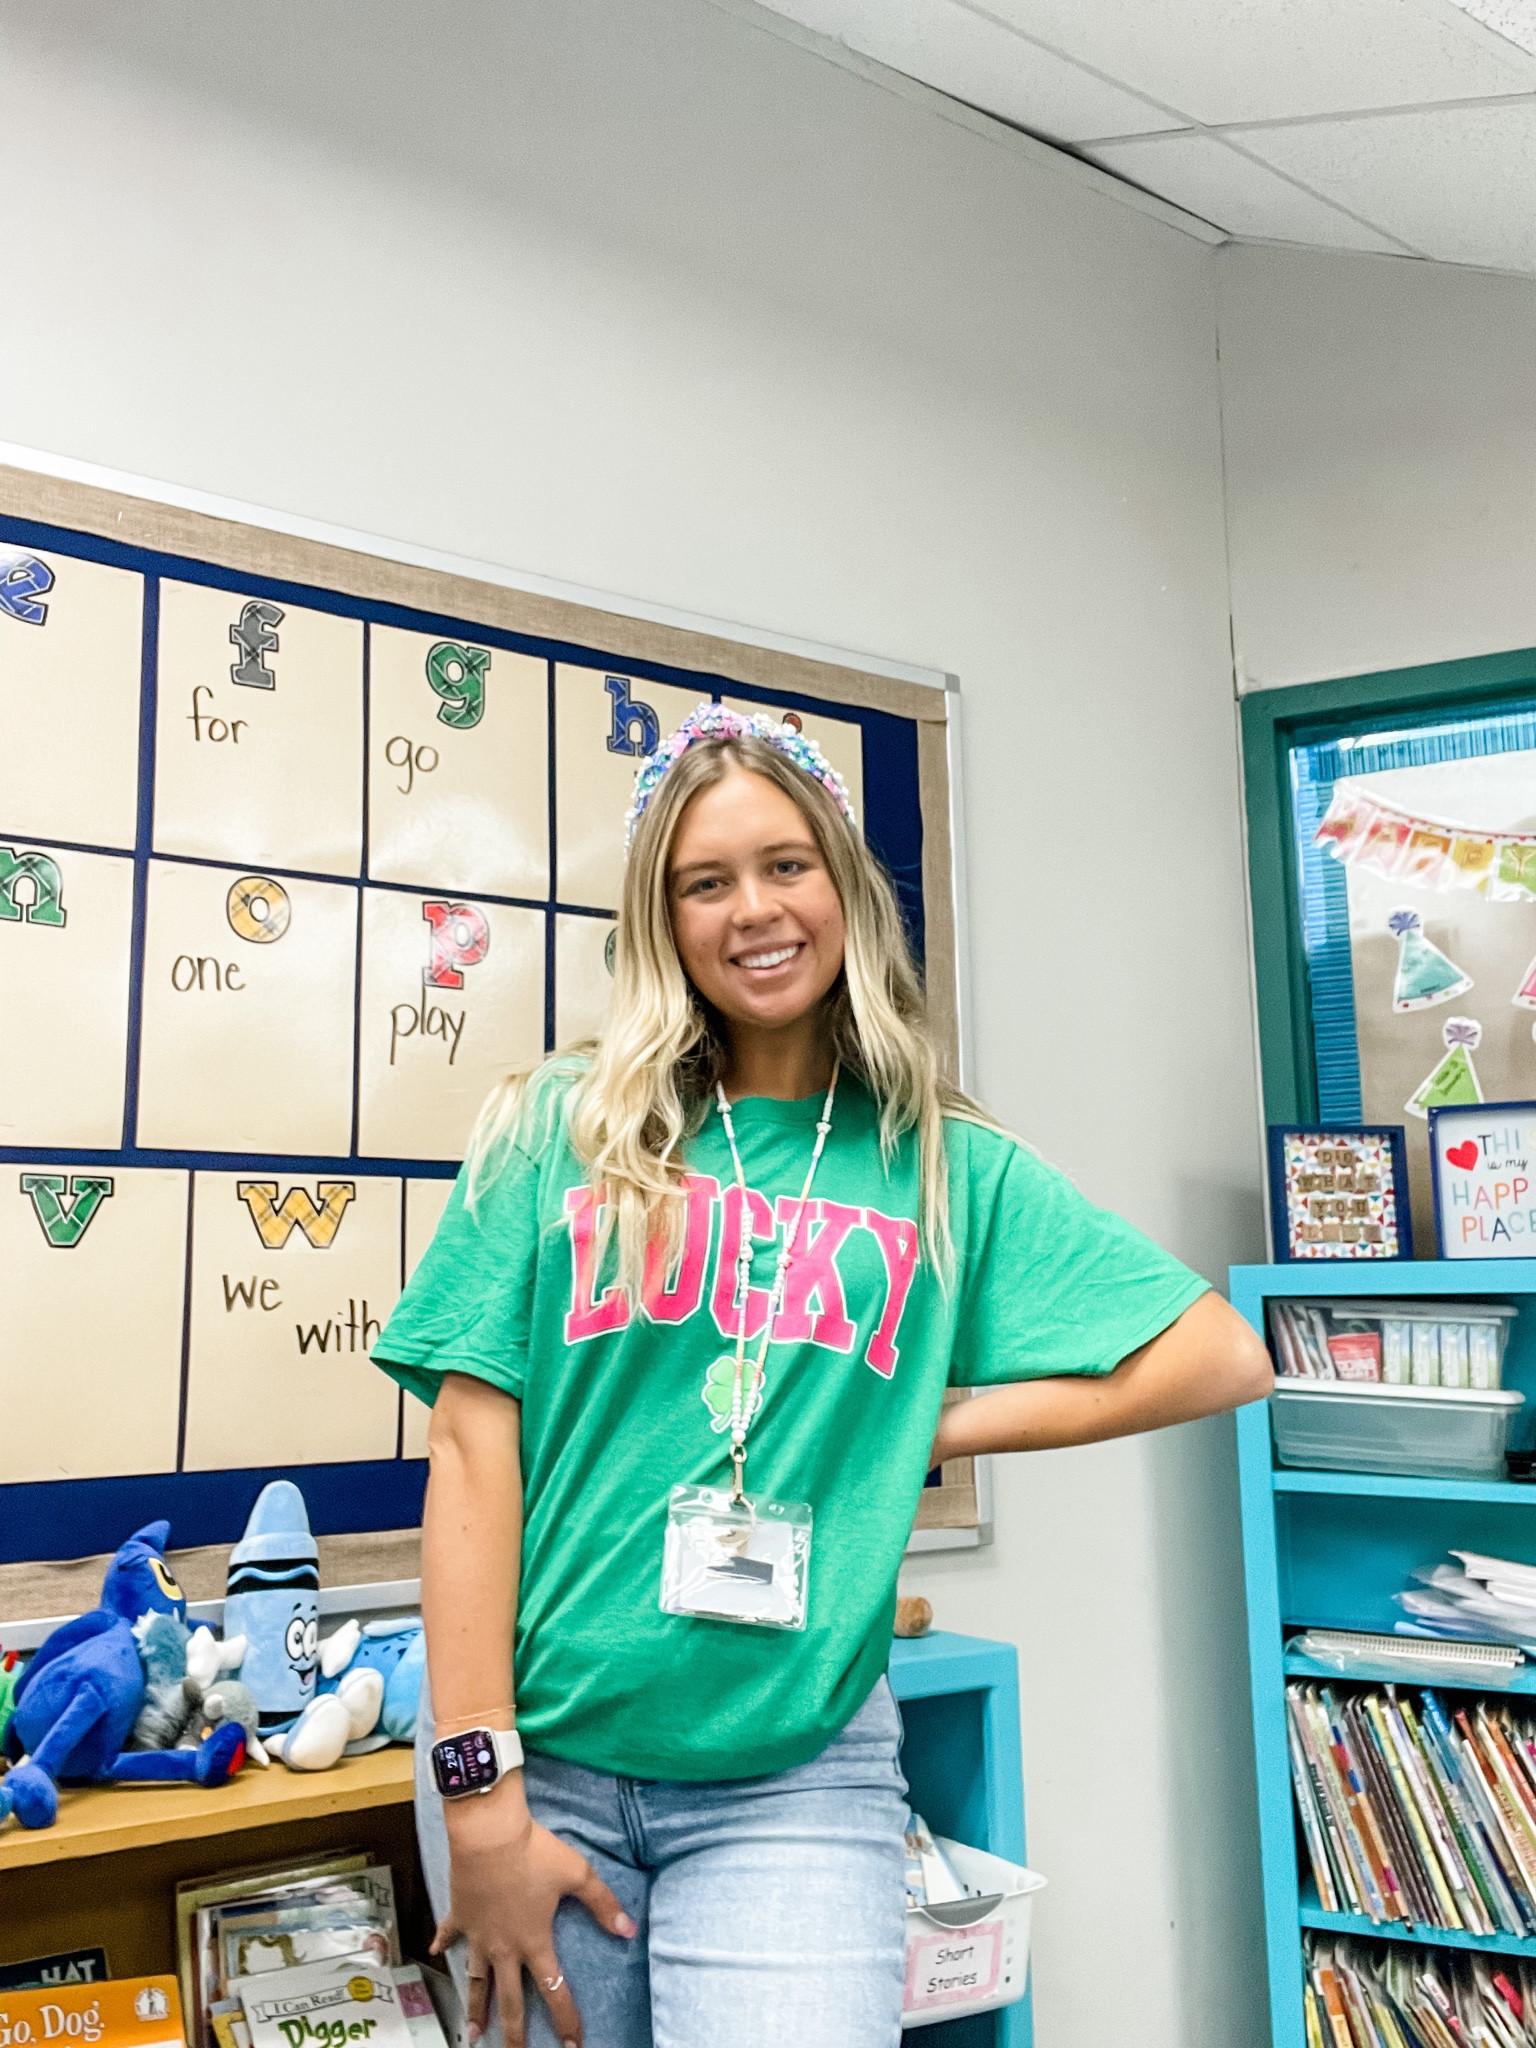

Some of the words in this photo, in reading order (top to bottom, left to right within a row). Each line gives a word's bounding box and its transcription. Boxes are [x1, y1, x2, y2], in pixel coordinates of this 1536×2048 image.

[0, 552, 55, 626] e
[229, 600, 286, 691] f
[186, 685, 249, 744] for
[425, 641, 491, 729] g
[604, 675, 660, 758] h
[385, 736, 440, 795] go
[0, 847, 67, 928] n
[171, 955, 246, 992] one
[423, 901, 490, 990] p
[390, 986, 466, 1066] play
[1462, 1209, 1536, 1243] PLACE
[222, 1274, 283, 1313] we
[564, 1173, 921, 1380] LUCKY
[296, 1299, 383, 1355] with
[41, 1958, 96, 1983] HAT
[927, 1971, 977, 1993] Stories
[935, 1946, 974, 1965] Short
[278, 2014, 378, 2048] Digger
